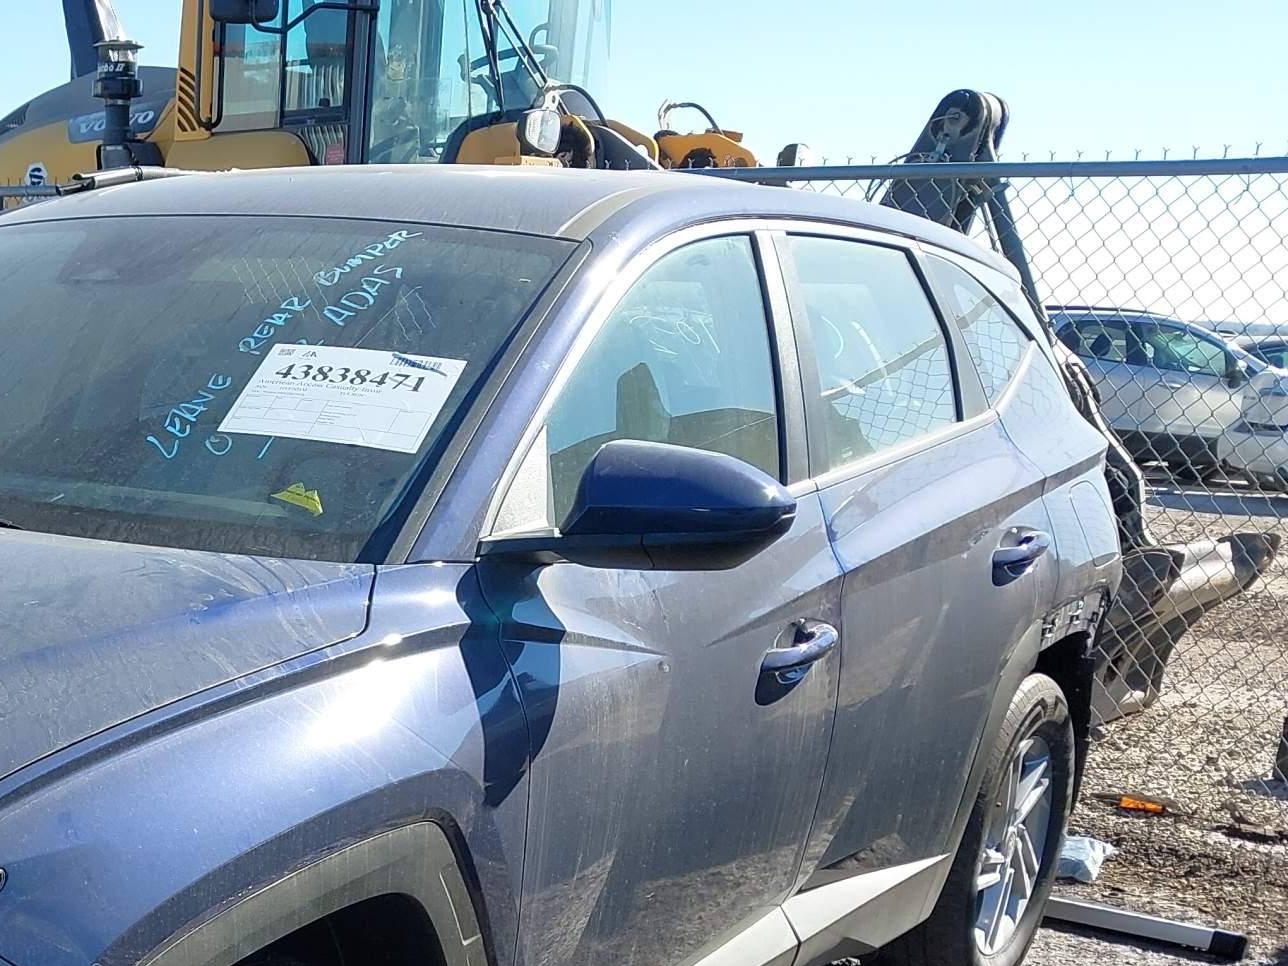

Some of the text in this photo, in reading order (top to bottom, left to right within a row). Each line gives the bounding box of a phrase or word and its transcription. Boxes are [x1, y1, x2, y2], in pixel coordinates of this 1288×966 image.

[79, 110, 155, 134] VOVO
[322, 264, 404, 326] ADAS
[146, 230, 423, 459] LEAVE REAR BUMPER
[275, 363, 426, 393] 43838471
